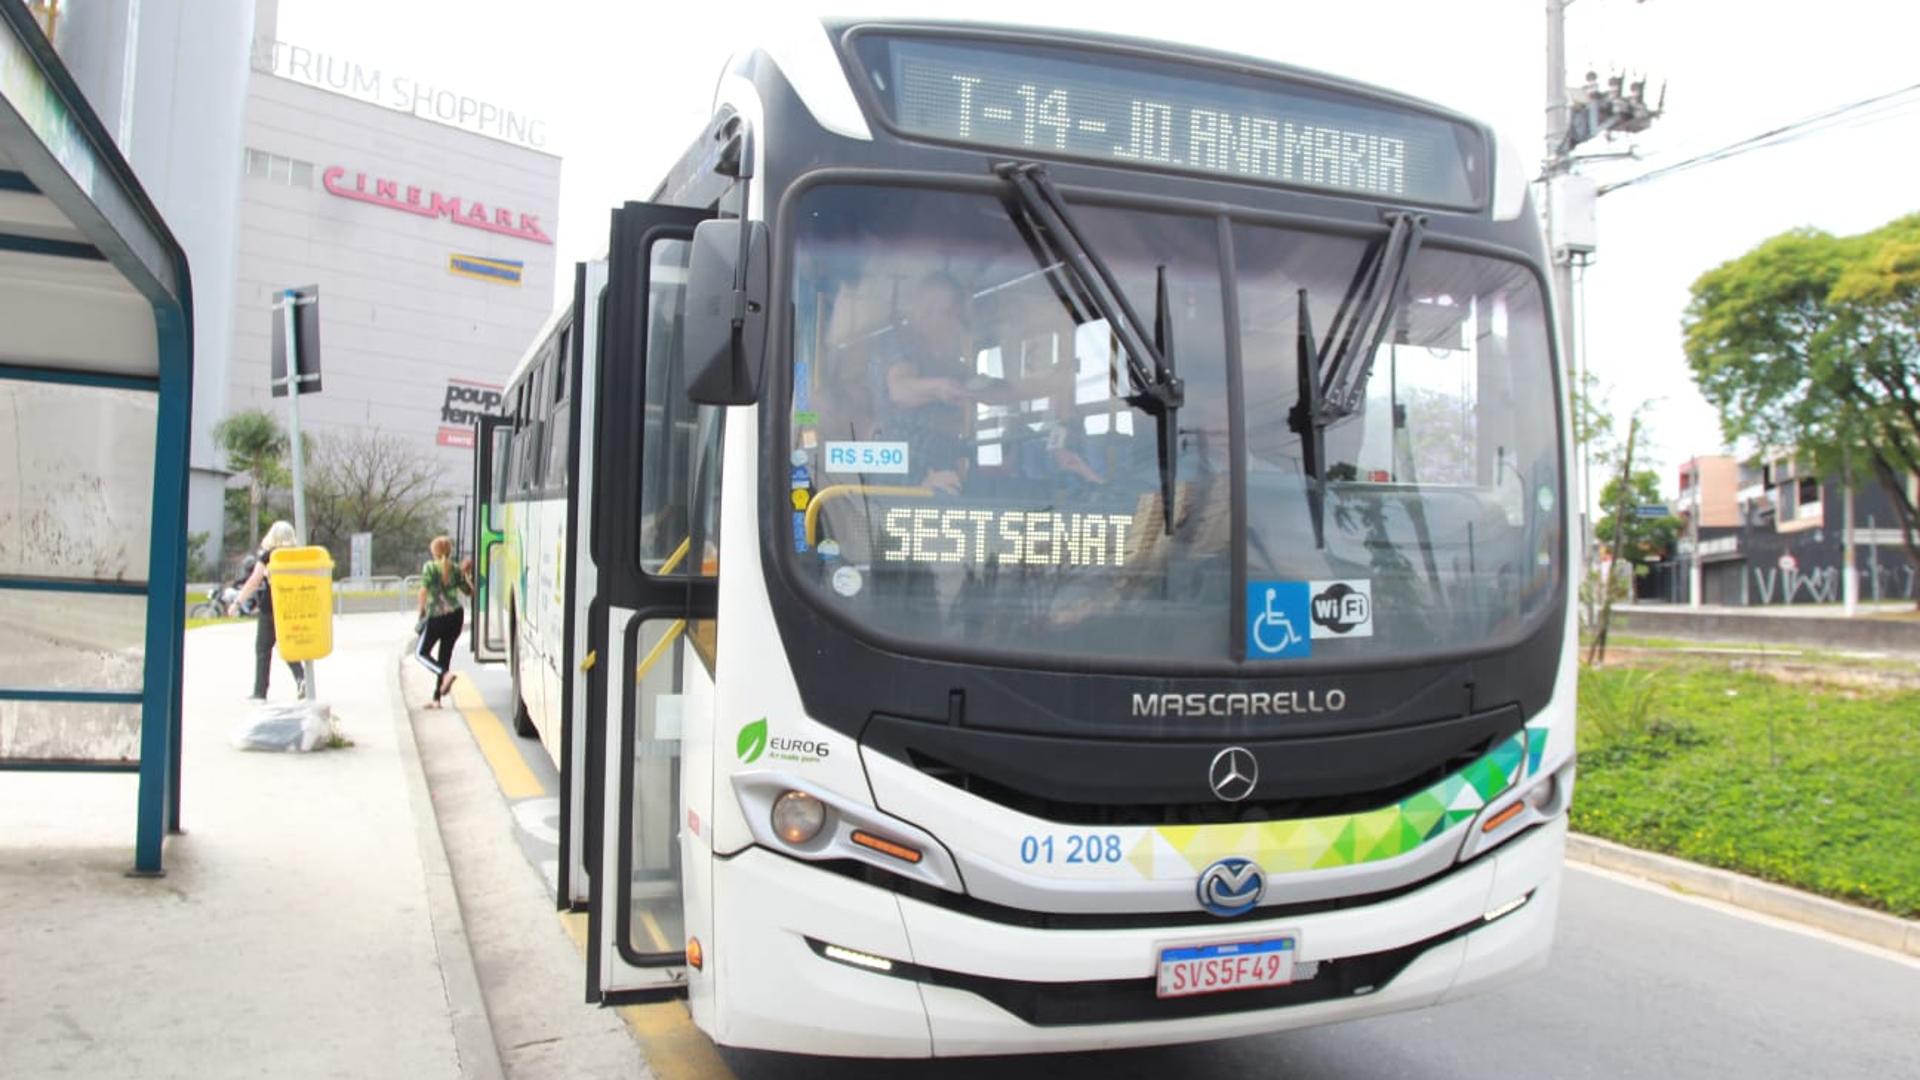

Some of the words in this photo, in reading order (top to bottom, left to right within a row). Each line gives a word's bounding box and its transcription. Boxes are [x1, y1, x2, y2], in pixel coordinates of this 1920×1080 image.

[251, 35, 381, 100] TRIUM
[392, 76, 547, 148] SHOPPING
[322, 165, 554, 245] CINEMARK
[445, 385, 503, 411] poup
[831, 448, 856, 464] R$
[863, 448, 902, 466] 5,90
[886, 508, 993, 562] SEST
[999, 511, 1133, 566] SENAT
[1132, 689, 1346, 716] MASCARELLO
[1021, 835, 1053, 864] 01
[1066, 834, 1122, 863] 208
[1173, 954, 1280, 990] SVS5F49
